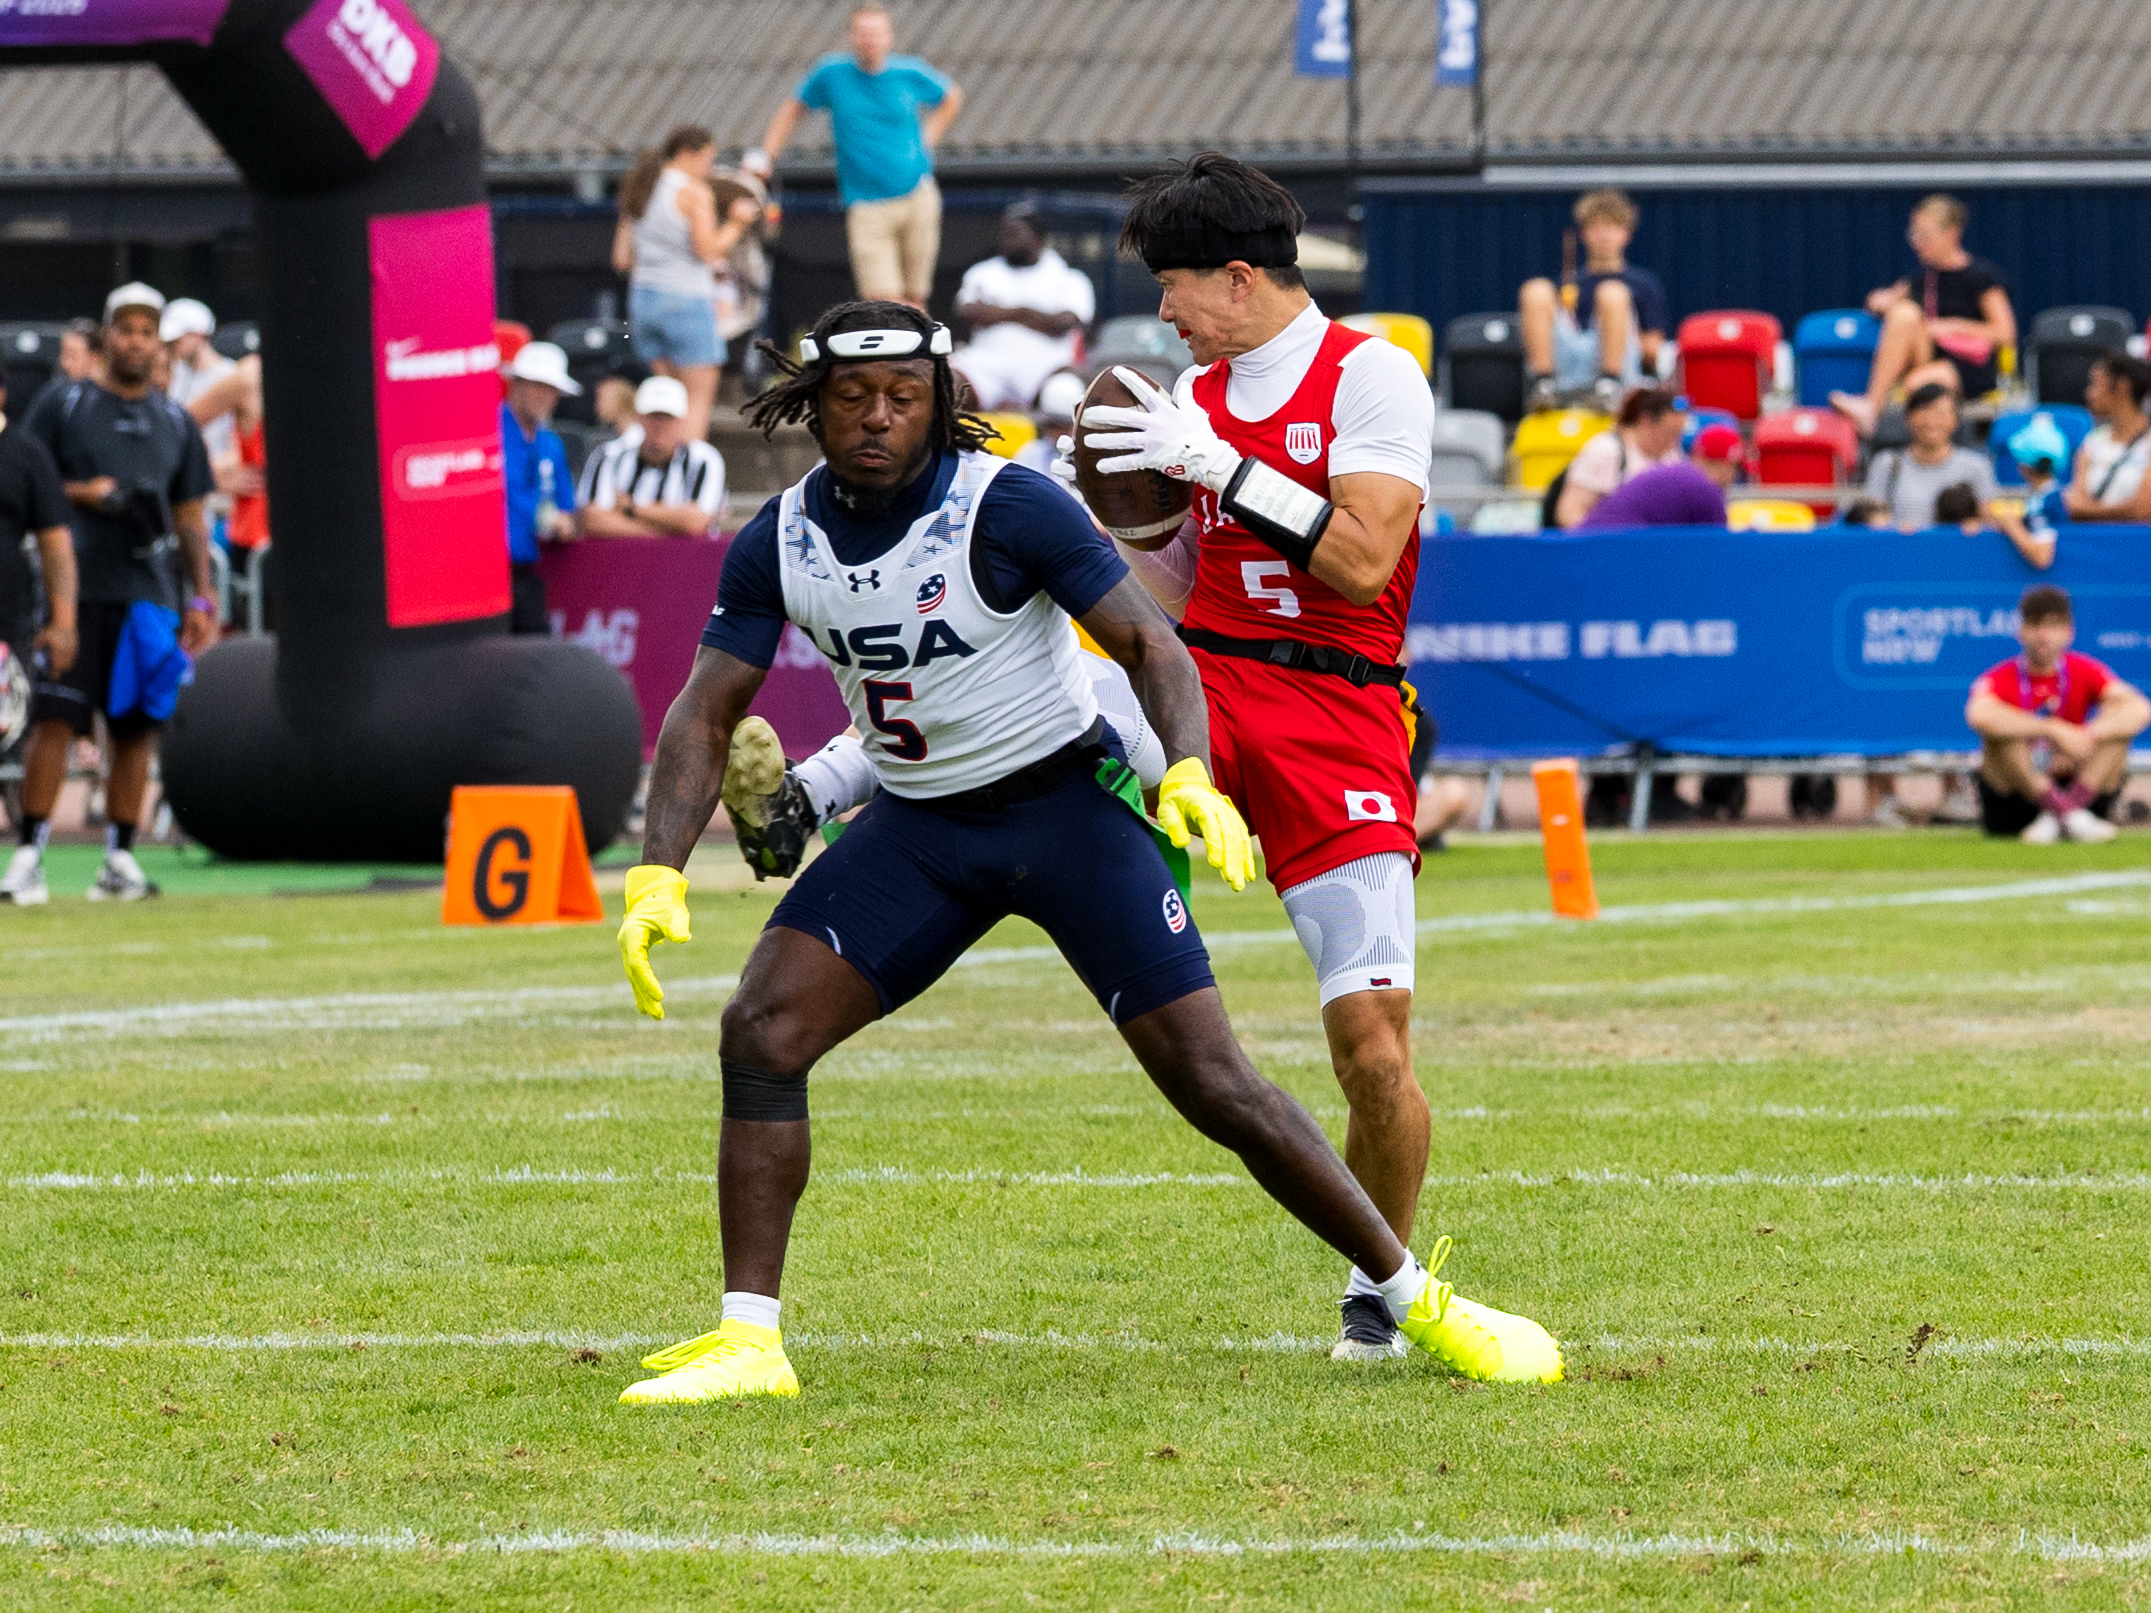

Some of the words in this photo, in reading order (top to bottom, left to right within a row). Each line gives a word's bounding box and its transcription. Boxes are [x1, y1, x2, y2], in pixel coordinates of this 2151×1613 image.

[338, 0, 418, 88] DKB
[1241, 560, 1301, 619] 5
[799, 618, 979, 671] USA
[1579, 618, 1738, 659] FLAG
[1863, 607, 2021, 637] SPORTLA
[863, 678, 928, 761] 5
[474, 826, 532, 922] G
